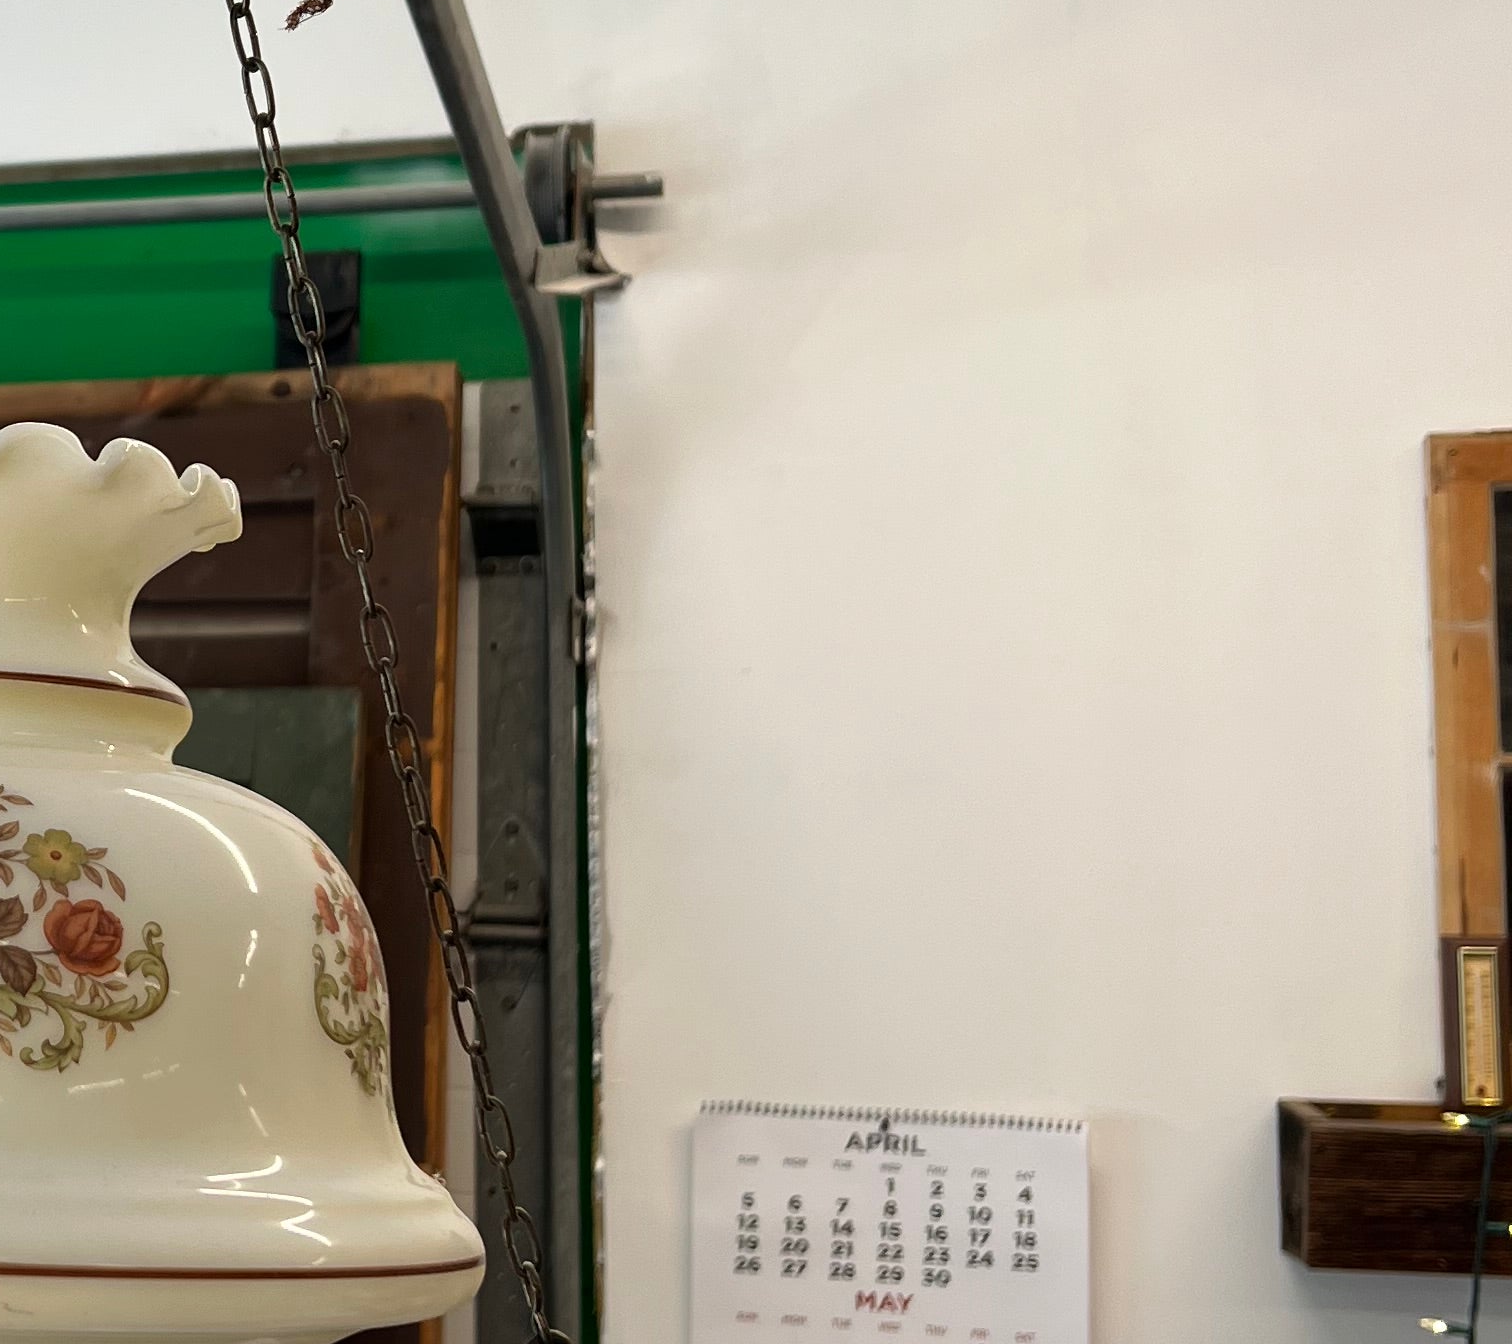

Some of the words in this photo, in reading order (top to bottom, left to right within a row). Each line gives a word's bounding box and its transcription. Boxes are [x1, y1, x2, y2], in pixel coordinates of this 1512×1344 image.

[844, 1131, 926, 1157] APRIL
[886, 1178, 895, 1196] 1
[930, 1180, 944, 1199] 2
[974, 1183, 987, 1202] 3
[1017, 1186, 1033, 1204] 4
[742, 1192, 755, 1210] 5
[788, 1195, 802, 1213] 6
[836, 1198, 849, 1216] 7
[929, 1203, 944, 1222] 9
[968, 1206, 993, 1225] 10
[1016, 1209, 1035, 1228] 11
[737, 1214, 759, 1232] 12
[784, 1216, 807, 1235] 13
[830, 1219, 856, 1238] 14
[878, 1222, 902, 1241] 15
[924, 1225, 948, 1244] 16
[968, 1228, 992, 1247] 17
[1014, 1231, 1038, 1251] 18
[780, 1237, 810, 1257] 20
[831, 1240, 854, 1259] 21
[876, 1243, 904, 1263] 22
[922, 1246, 951, 1266] 23
[966, 1249, 995, 1269] 24
[1011, 1253, 1040, 1273] 25
[734, 1256, 761, 1275] 26
[781, 1259, 808, 1277] 27
[829, 1262, 856, 1281] 28
[922, 1268, 952, 1288] 30
[855, 1290, 915, 1315] MAY
